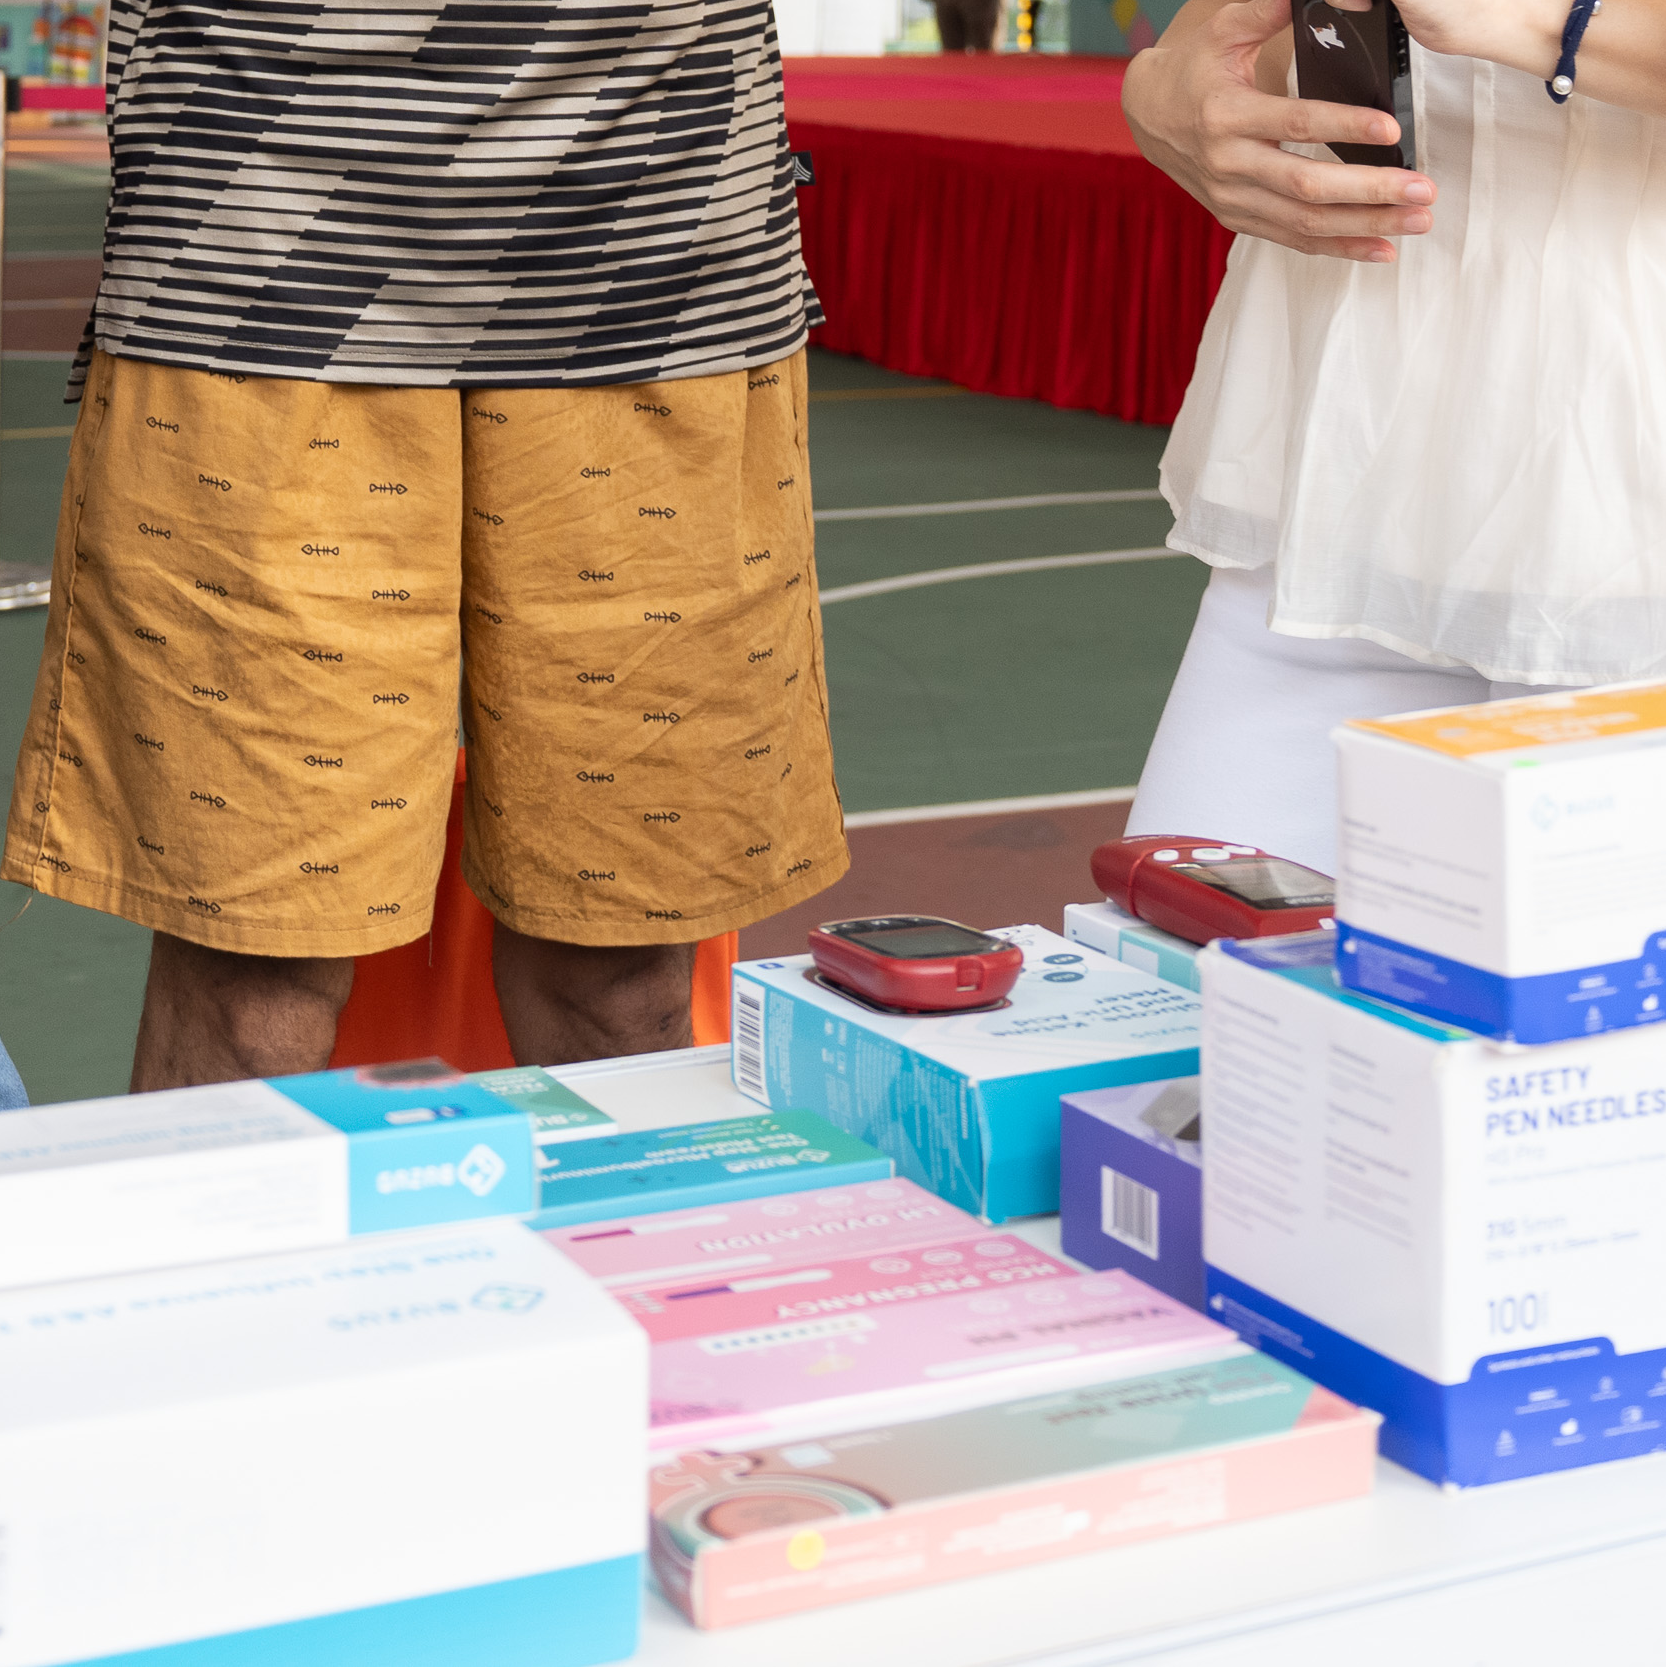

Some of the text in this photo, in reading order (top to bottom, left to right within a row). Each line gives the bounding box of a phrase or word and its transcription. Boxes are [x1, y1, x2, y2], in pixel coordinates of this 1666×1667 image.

[1094, 987, 1171, 1005] Meter
[1485, 1065, 1593, 1103] SAFETY
[1485, 1107, 1540, 1138] PEN
[695, 1203, 944, 1255] LH OVULATION
[774, 1261, 1059, 1320] HCG PREGNANCY
[1487, 1293, 1538, 1335] 100
